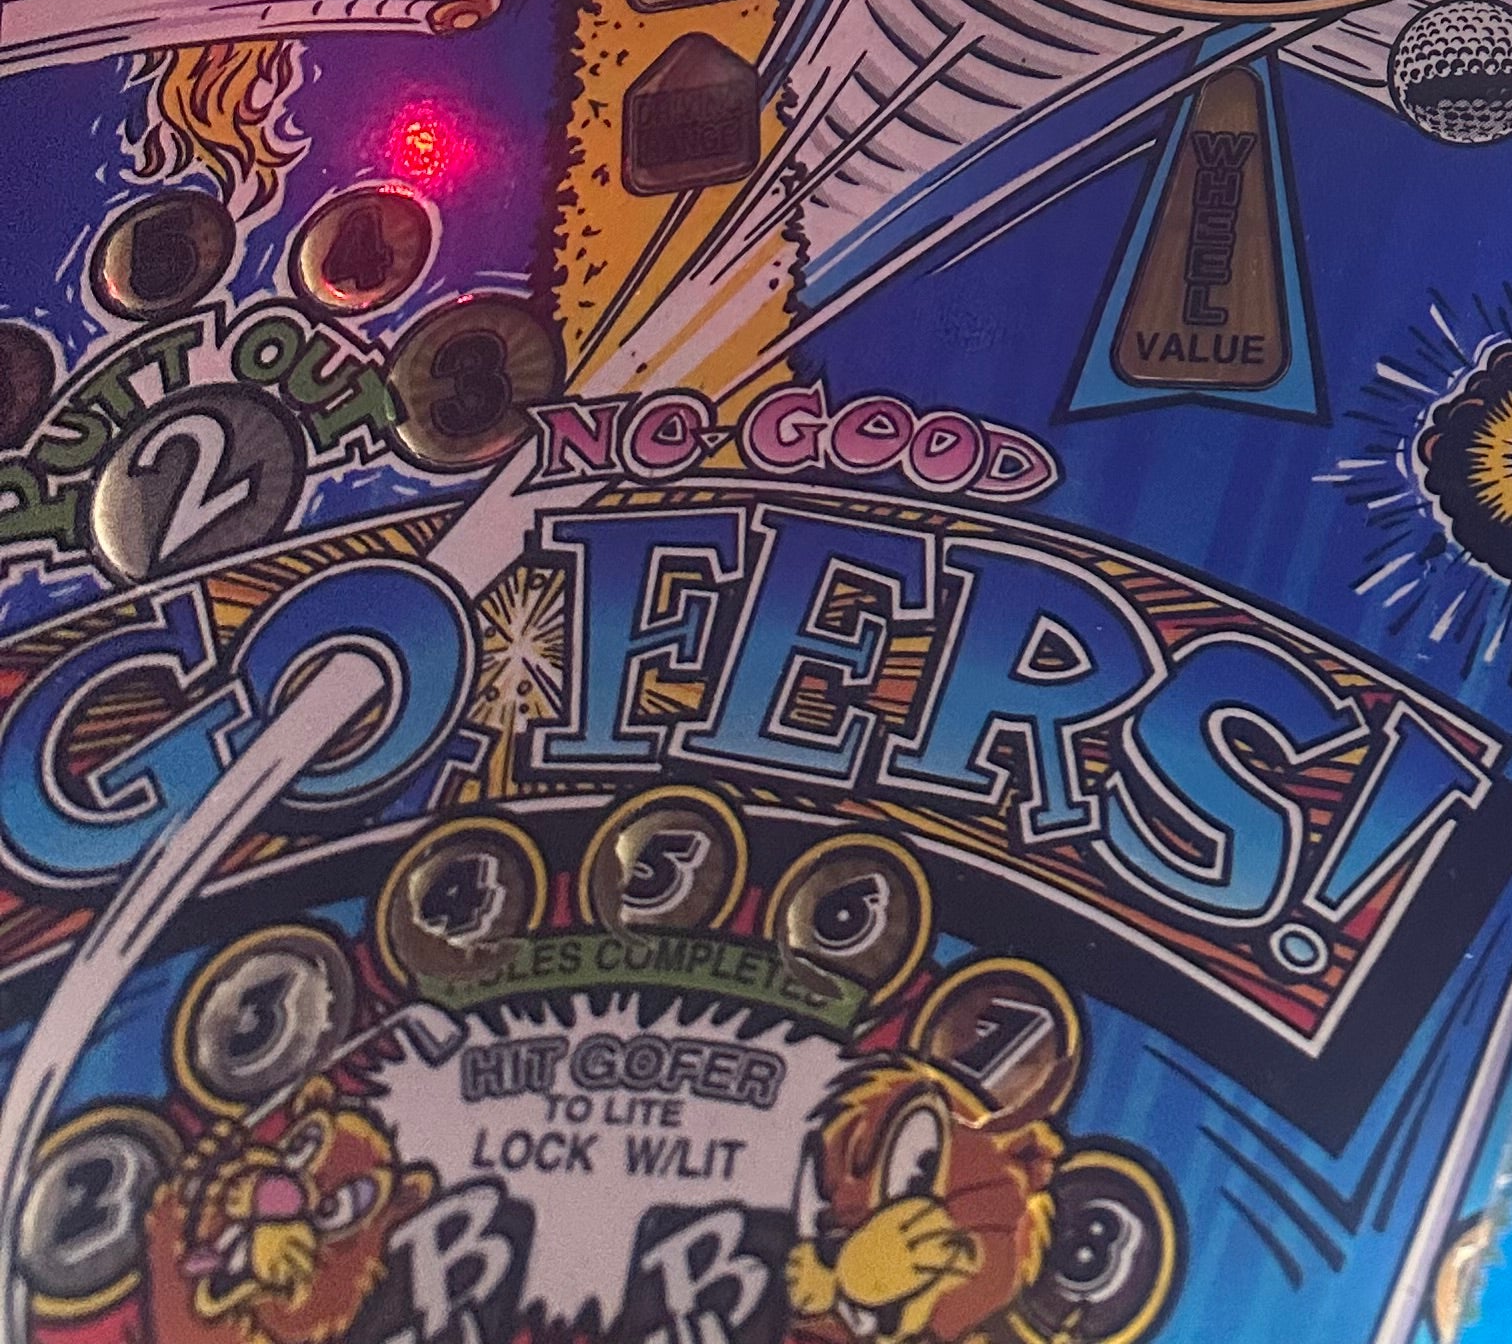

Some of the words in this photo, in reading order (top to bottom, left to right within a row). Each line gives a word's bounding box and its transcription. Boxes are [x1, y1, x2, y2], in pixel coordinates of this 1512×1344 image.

[322, 203, 393, 290] 4
[1181, 130, 1256, 327] WHEEL
[232, 315, 397, 450] OUT
[430, 328, 514, 436] 3
[1134, 332, 1267, 367] VALUE
[128, 411, 254, 563] 2
[0, 505, 1493, 980] GOFERS!
[412, 850, 505, 946] 4
[460, 1035, 568, 1102] HIT
[570, 1033, 786, 1109] GOFER
[545, 1094, 592, 1124] TO
[604, 1097, 686, 1128] LITE
[473, 1127, 597, 1172] LOCK
[625, 1134, 748, 1180] W/LIT
[1053, 1202, 1141, 1301] 8
